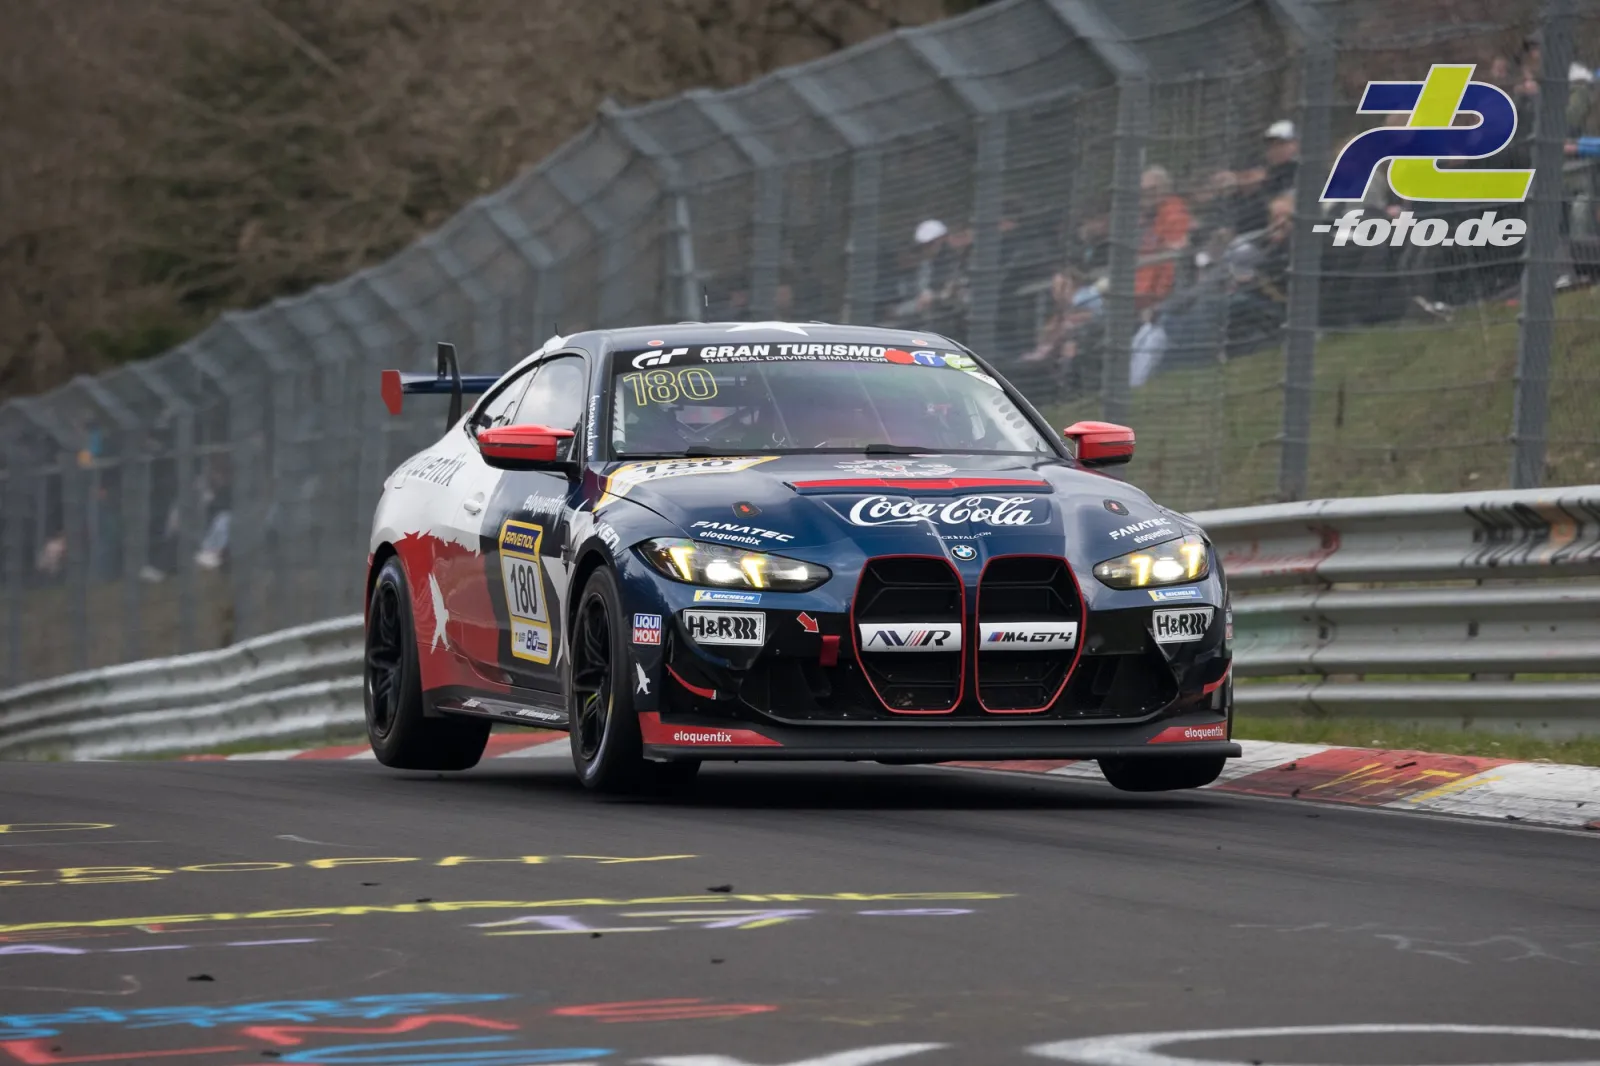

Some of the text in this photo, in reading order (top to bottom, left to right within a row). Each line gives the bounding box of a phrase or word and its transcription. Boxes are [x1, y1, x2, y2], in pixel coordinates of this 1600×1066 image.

[699, 344, 886, 359] GRAN TURISMO
[818, 355, 889, 363] SIMULATOR
[622, 367, 718, 407] 180
[849, 495, 1037, 527] Coca-Cola
[690, 520, 795, 543] FANATEC
[1108, 517, 1172, 541] FANATEC
[504, 531, 535, 549] RAVENOL
[699, 530, 763, 546] eloquentix
[510, 563, 538, 615] 180
[712, 592, 756, 601] MICHELIN
[635, 615, 660, 629] LIQUI
[634, 629, 660, 642] MOLY
[673, 731, 732, 743] eloquentix
[1184, 726, 1224, 739] eloquentix
